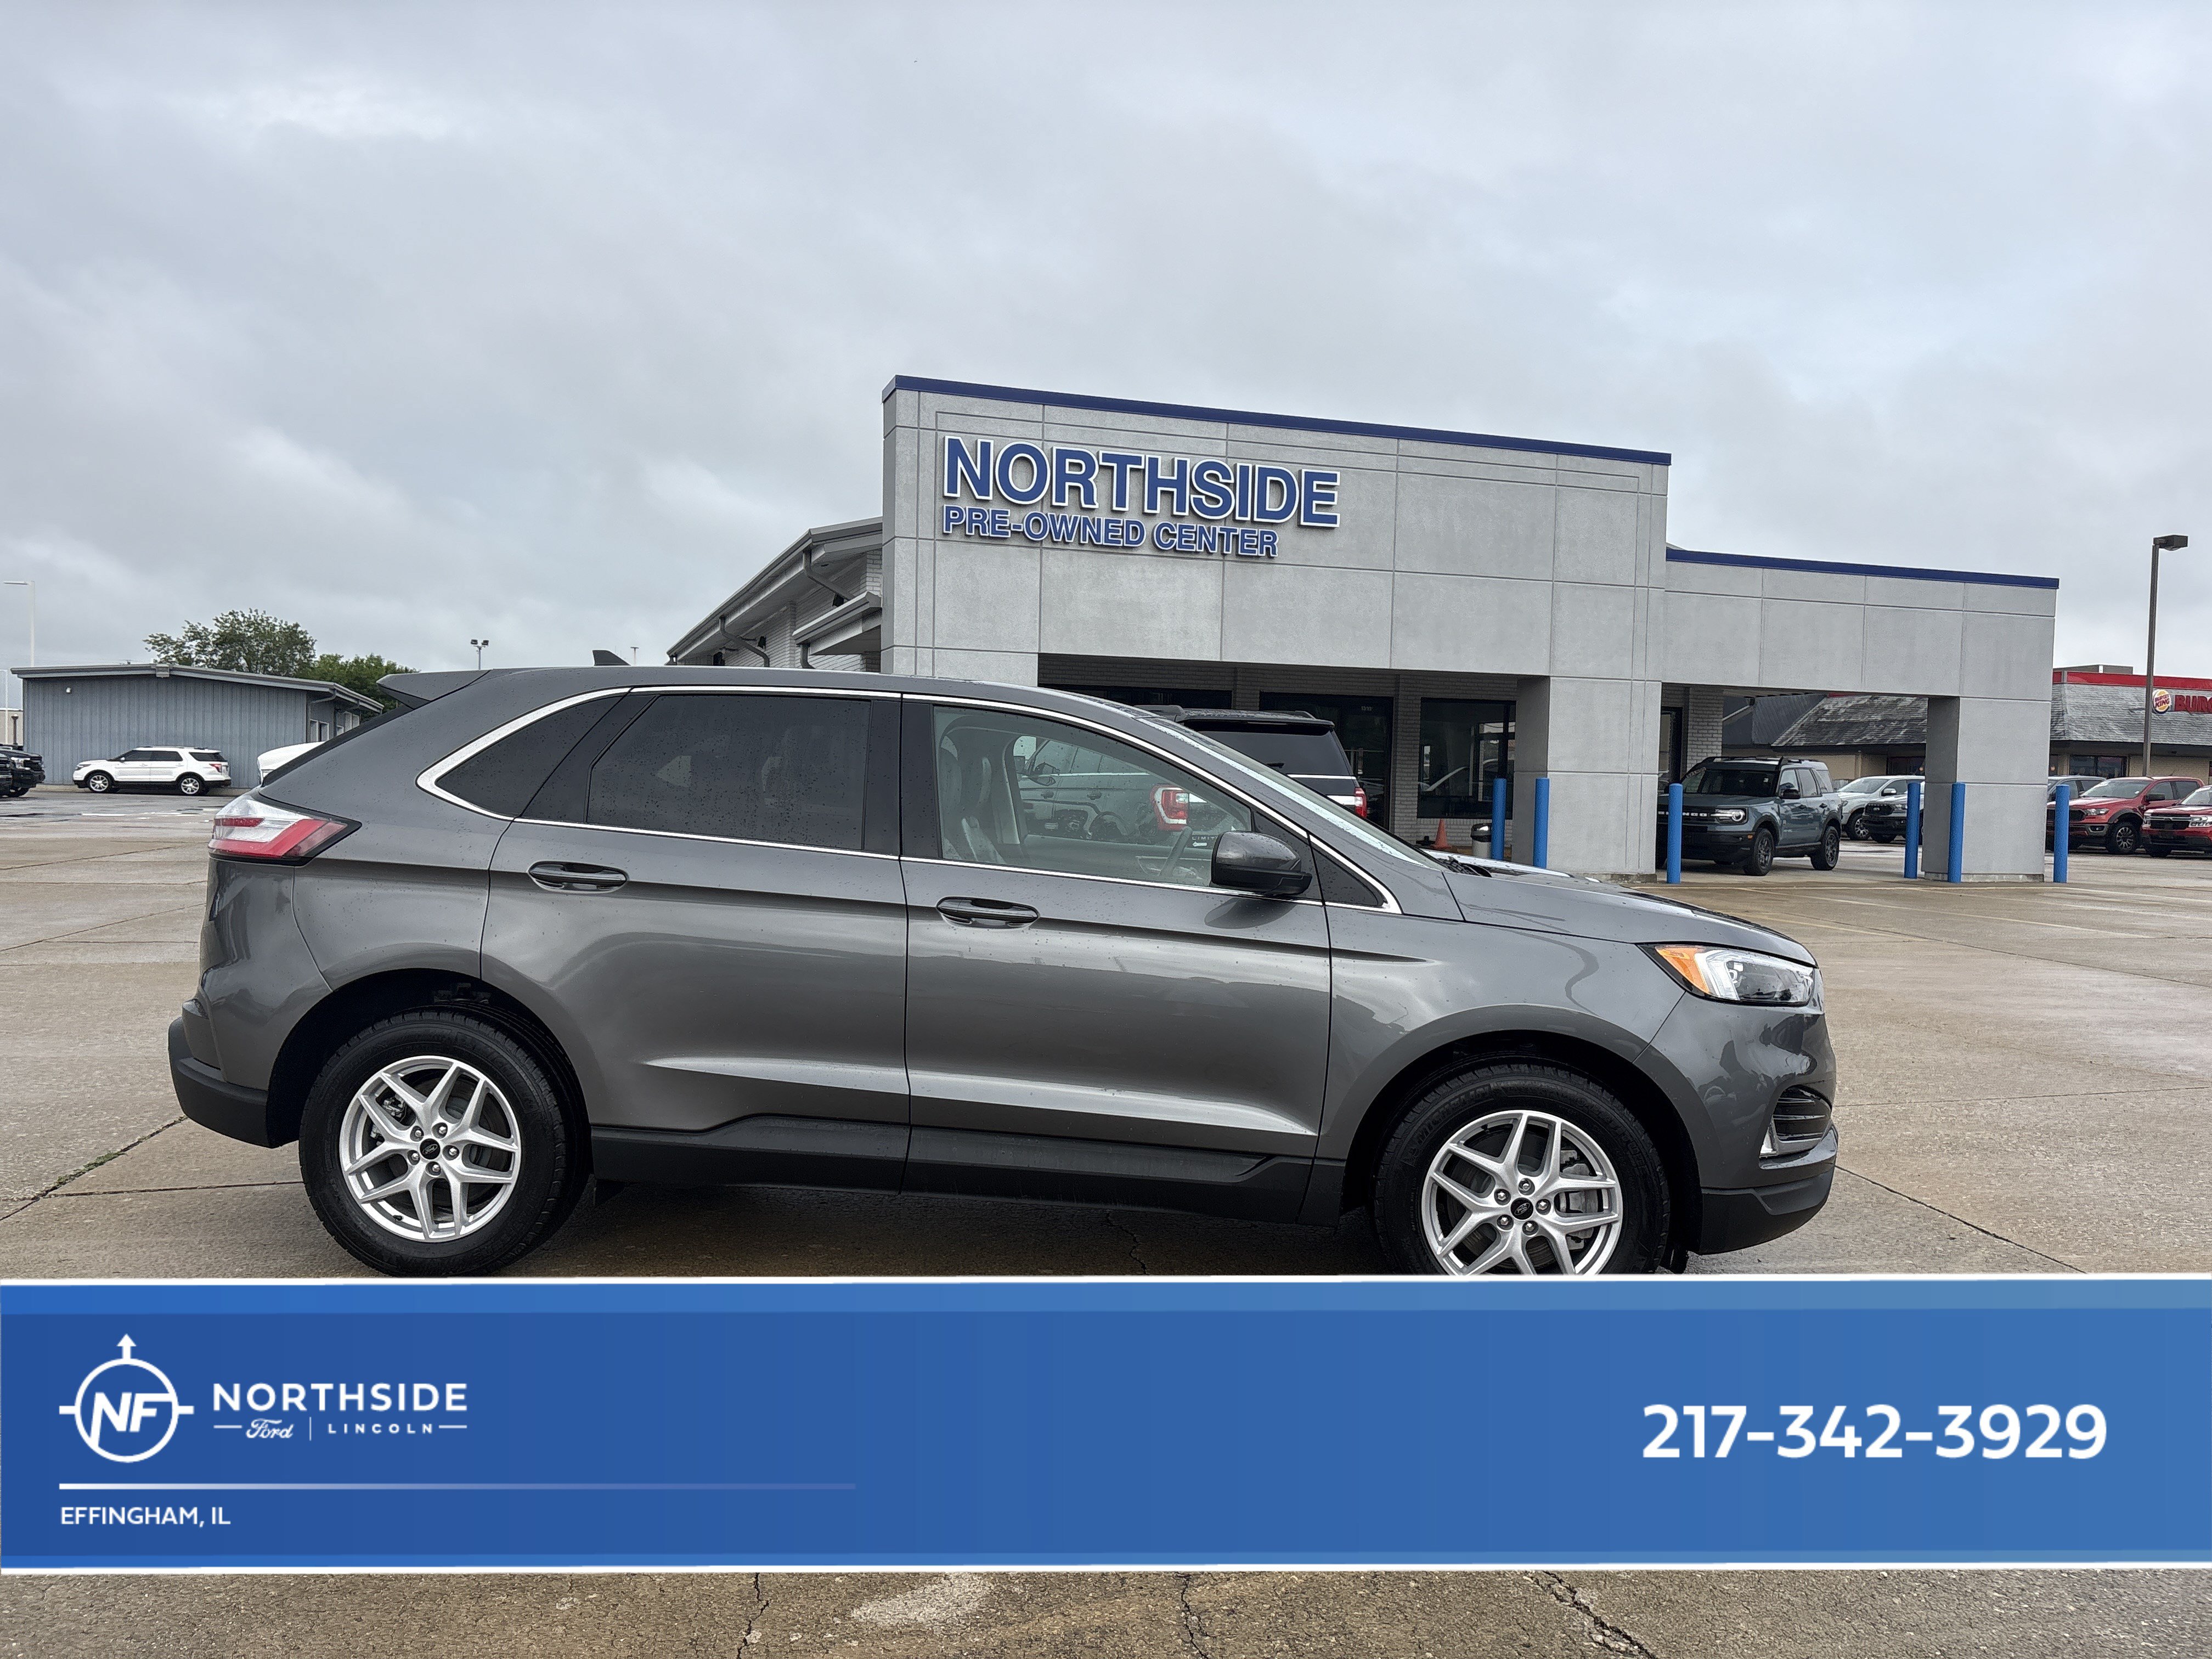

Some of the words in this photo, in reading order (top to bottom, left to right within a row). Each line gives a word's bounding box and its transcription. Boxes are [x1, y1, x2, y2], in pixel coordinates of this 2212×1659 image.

[944, 436, 1340, 528] NORTHSIDE
[944, 505, 1147, 547] PRE-OWNED
[1154, 522, 1279, 557] CENTER
[2155, 698, 2170, 708] KING
